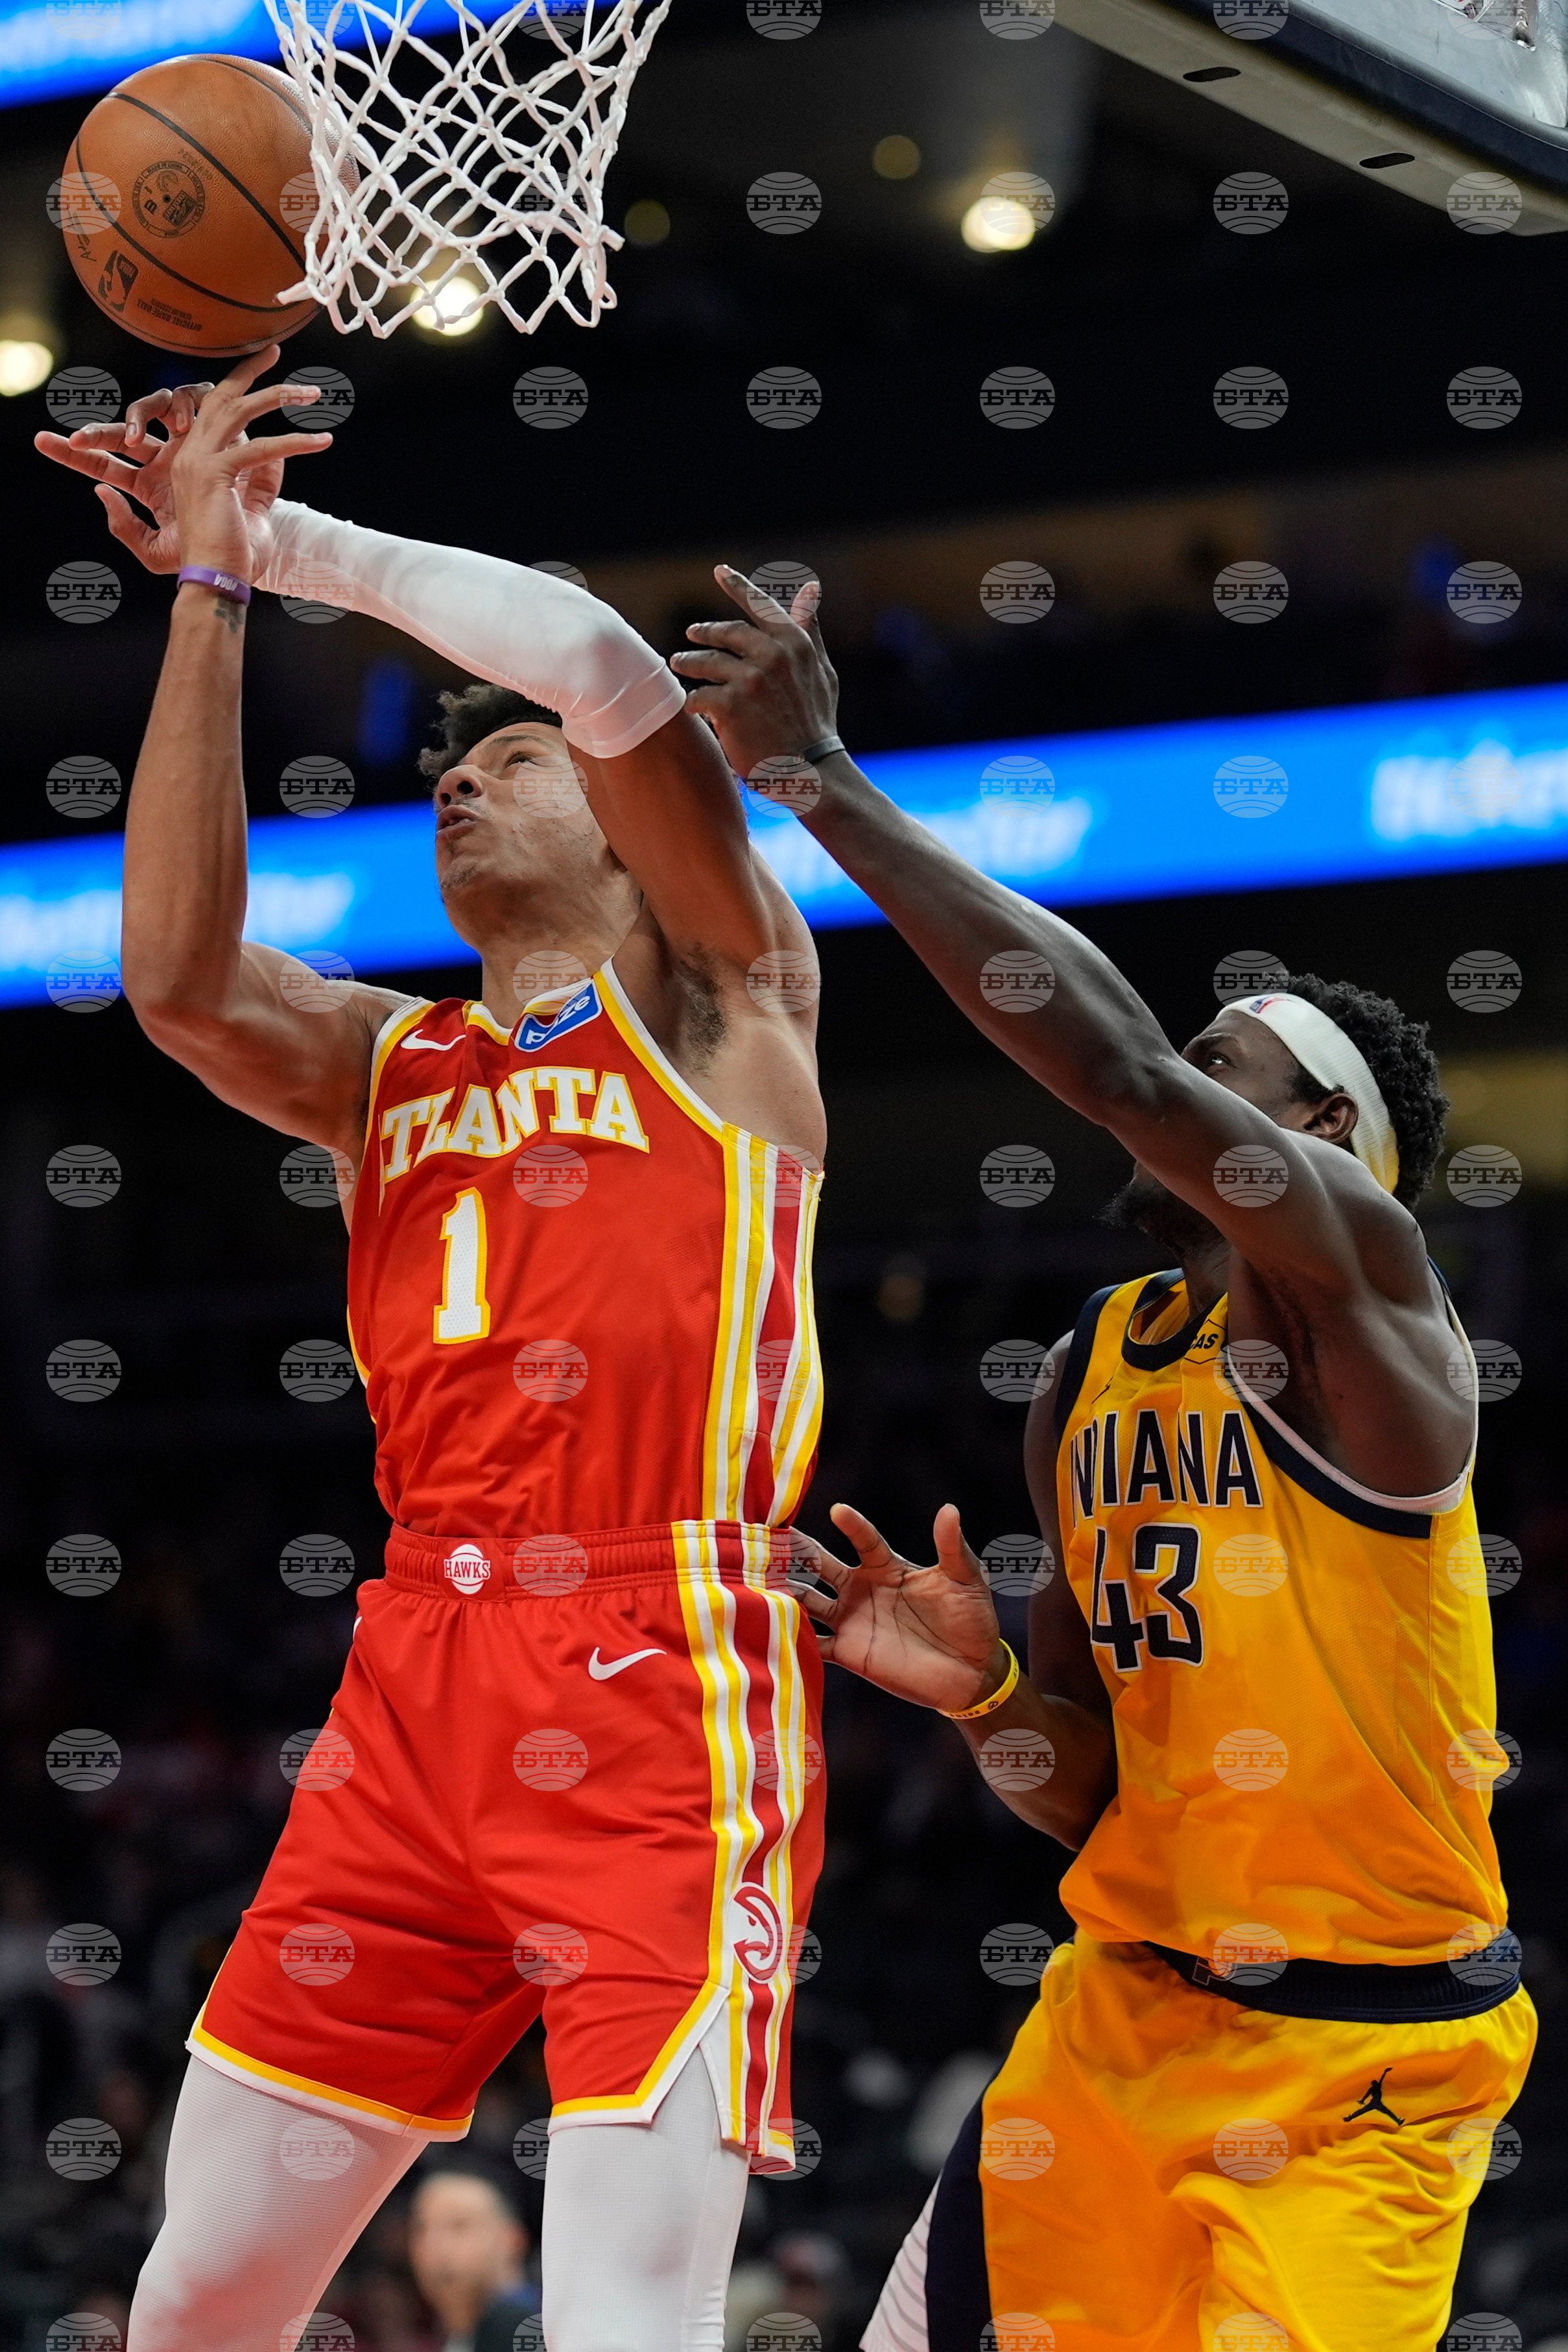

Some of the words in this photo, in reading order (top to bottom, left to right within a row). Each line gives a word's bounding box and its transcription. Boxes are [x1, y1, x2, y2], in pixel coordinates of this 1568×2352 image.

[525, 995, 591, 1045] pze
[380, 1066, 650, 1184] TLANTA
[433, 1186, 491, 1345] 1
[444, 1560, 490, 1579] HAWKS
[1090, 1522, 1204, 1674] 43
